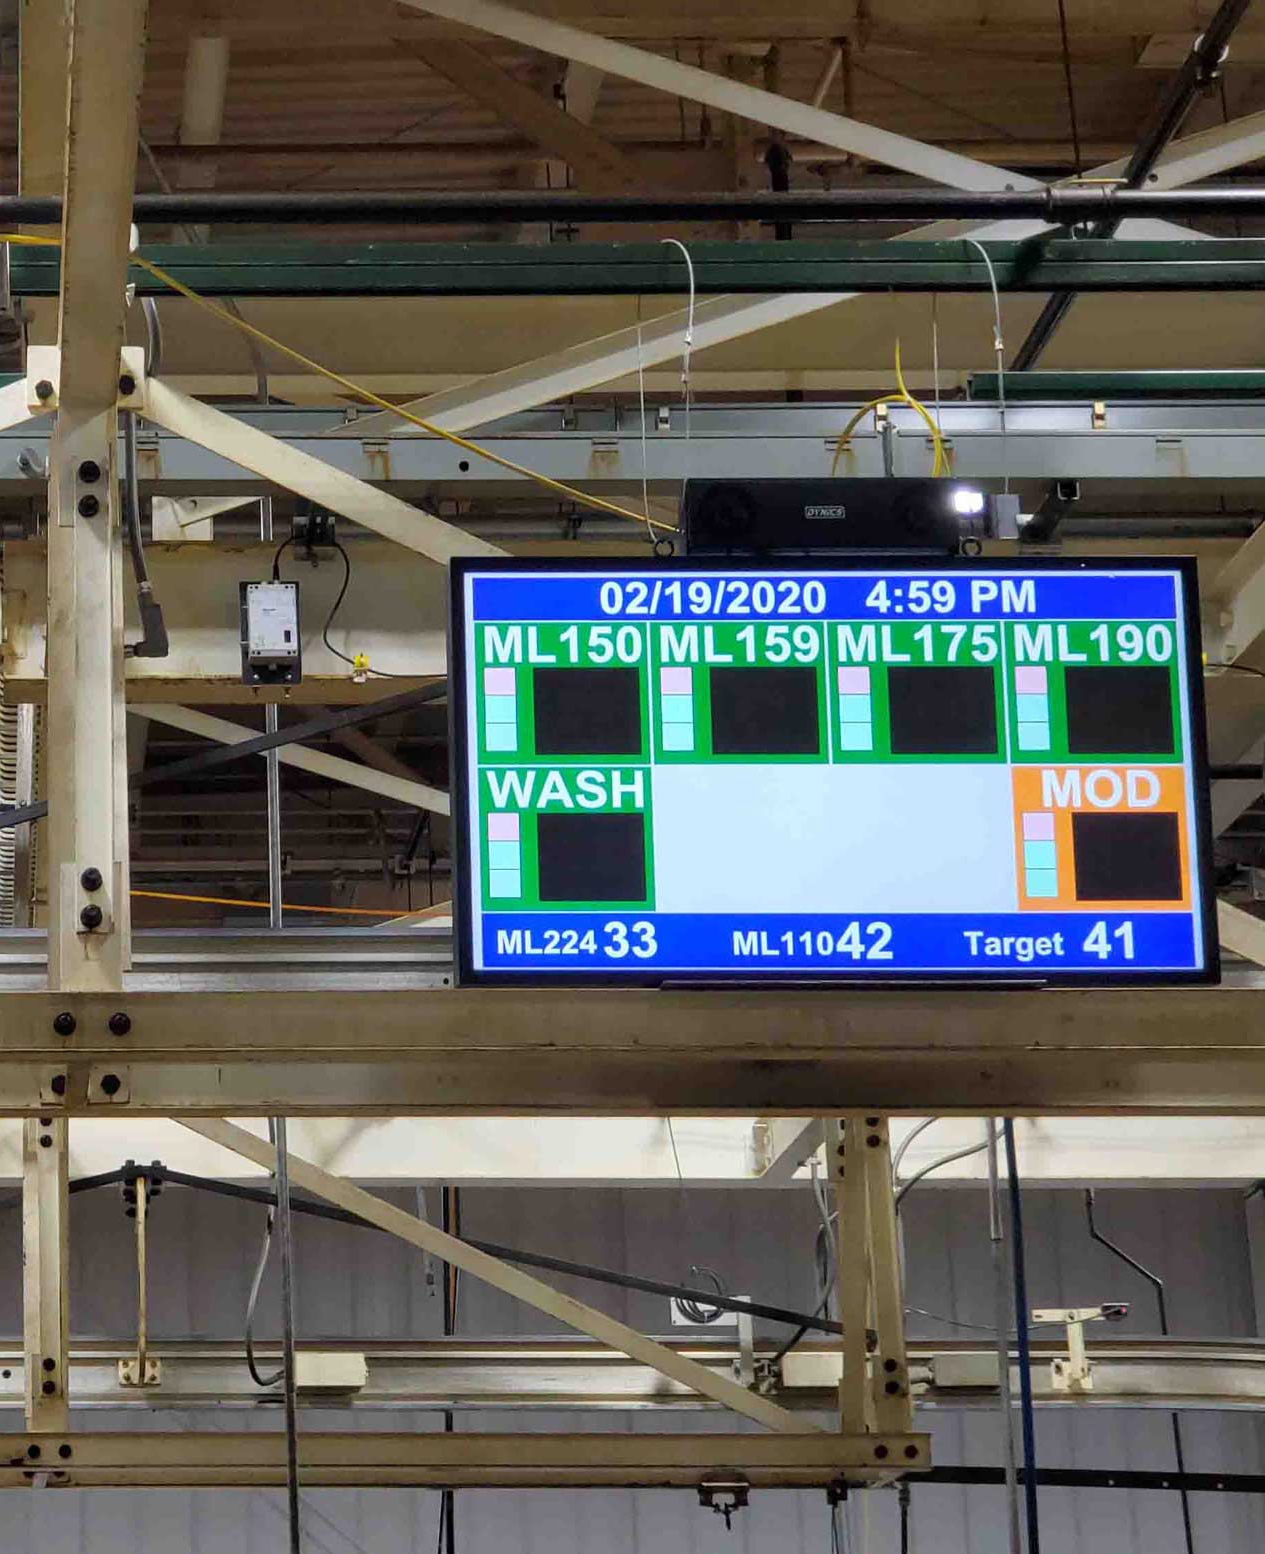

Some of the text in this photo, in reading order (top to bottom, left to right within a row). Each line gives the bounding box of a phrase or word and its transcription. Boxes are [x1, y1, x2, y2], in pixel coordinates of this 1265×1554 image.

[600, 580, 1036, 615] 02/19/2020 4:59 PM
[484, 625, 642, 663] ML150
[660, 625, 820, 663] ML159
[837, 624, 998, 662] ML175
[1013, 624, 1172, 662] ML190
[486, 770, 644, 809] WASH
[1041, 770, 1161, 808] MOD
[497, 921, 658, 958] ML224 33
[733, 921, 893, 960] ML110 42
[963, 921, 1134, 962] Target 41
